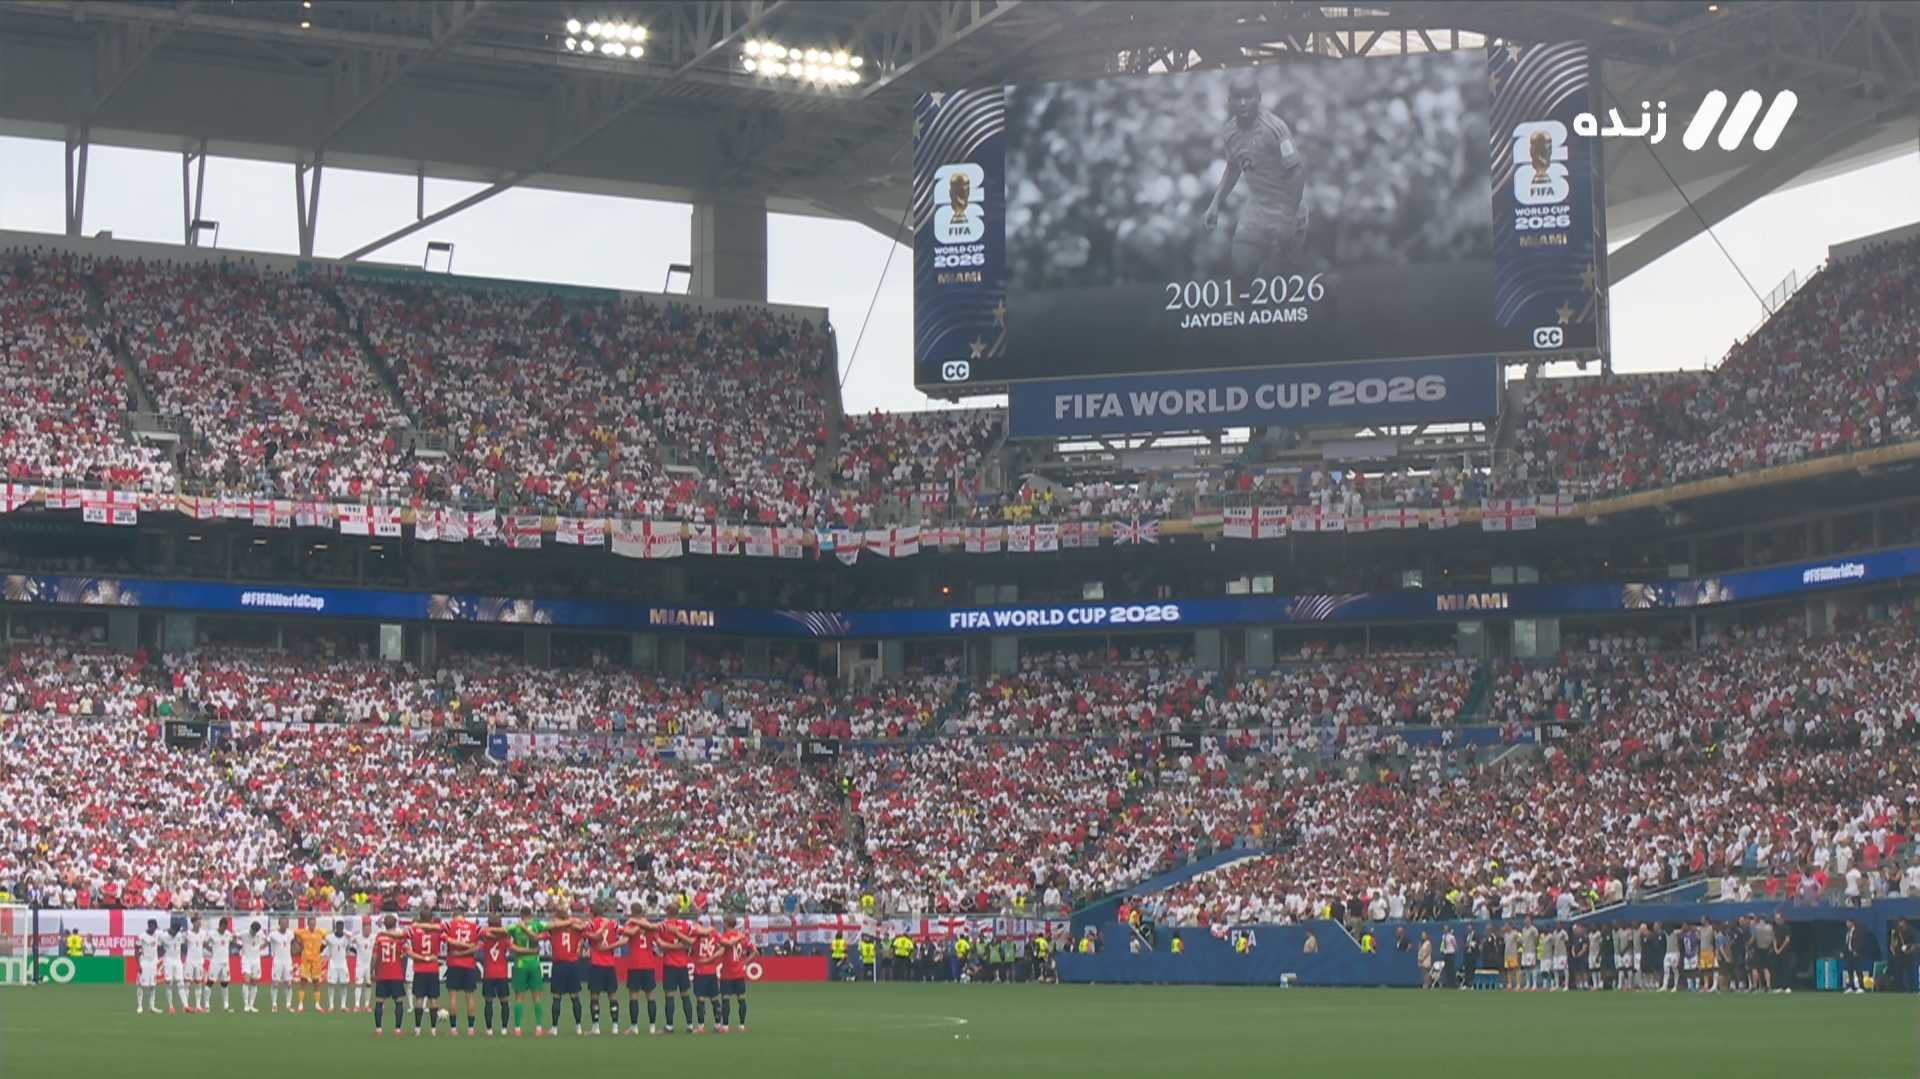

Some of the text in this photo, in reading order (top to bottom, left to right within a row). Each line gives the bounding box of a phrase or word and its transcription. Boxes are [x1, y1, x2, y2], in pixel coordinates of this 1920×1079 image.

[1530, 186, 1555, 197] FIFA
[1514, 205, 1570, 217] WORLD CUP
[948, 227, 971, 236] FIFA
[1515, 215, 1571, 230] 2026
[1519, 233, 1567, 247] MIAMI
[934, 244, 985, 255] WORLD CUP
[934, 253, 985, 268] 2026
[937, 271, 982, 283] MIAMI
[1165, 273, 1325, 310] 2001-2026
[1181, 307, 1308, 328] JAYDEN ADAMS
[1536, 331, 1561, 345] CC
[944, 364, 966, 379] CC
[1055, 375, 1447, 419] FIFA WORLD CUP 2026
[241, 592, 325, 611] #FIFAWorldCup
[1437, 592, 1508, 611] MIAMI
[649, 608, 714, 626] MIAMI
[950, 604, 1180, 628] FIFA WORLD CUP 2026
[421, 934, 431, 954] 5
[490, 941, 499, 961] 6
[561, 932, 571, 952] 9
[381, 943, 396, 963] 21
